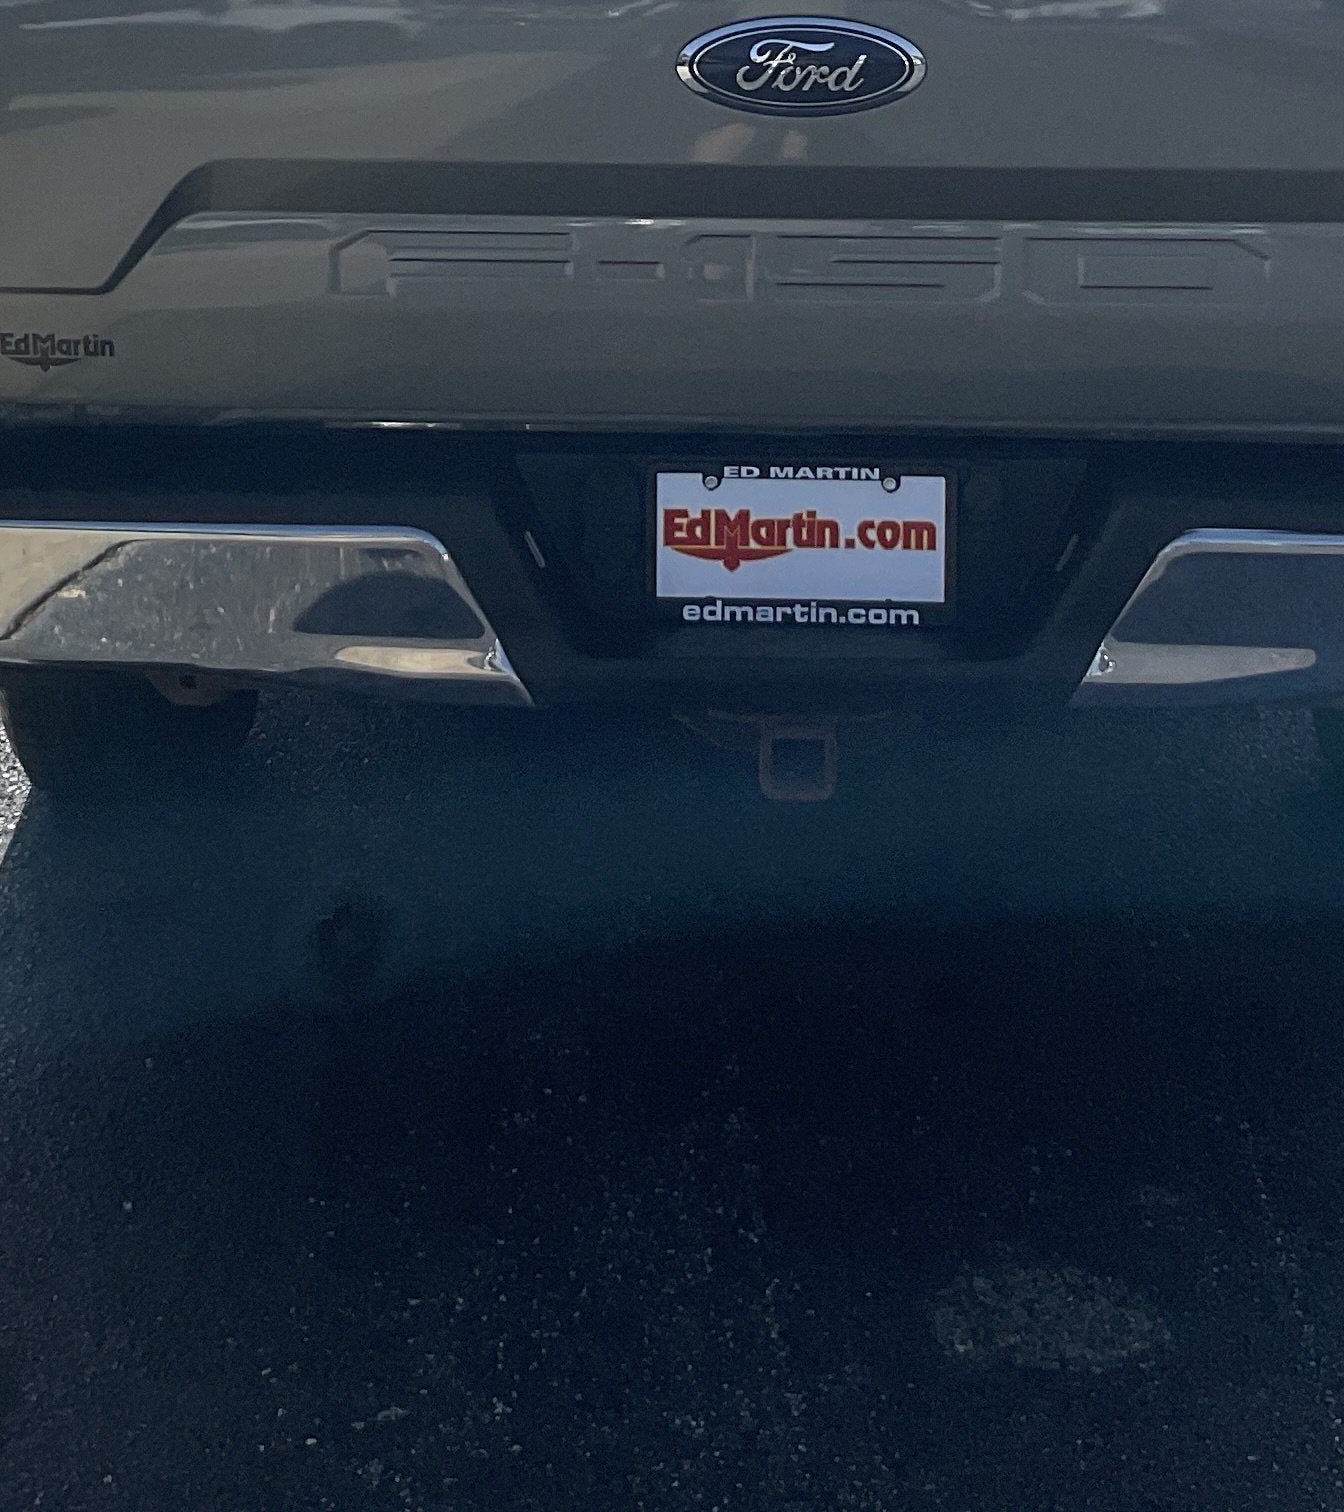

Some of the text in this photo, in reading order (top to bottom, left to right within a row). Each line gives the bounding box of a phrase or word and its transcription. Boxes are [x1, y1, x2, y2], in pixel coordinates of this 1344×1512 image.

[736, 39, 867, 91] Ford
[723, 466, 881, 480] ED MARTIN
[682, 599, 920, 625] edmartin.com
